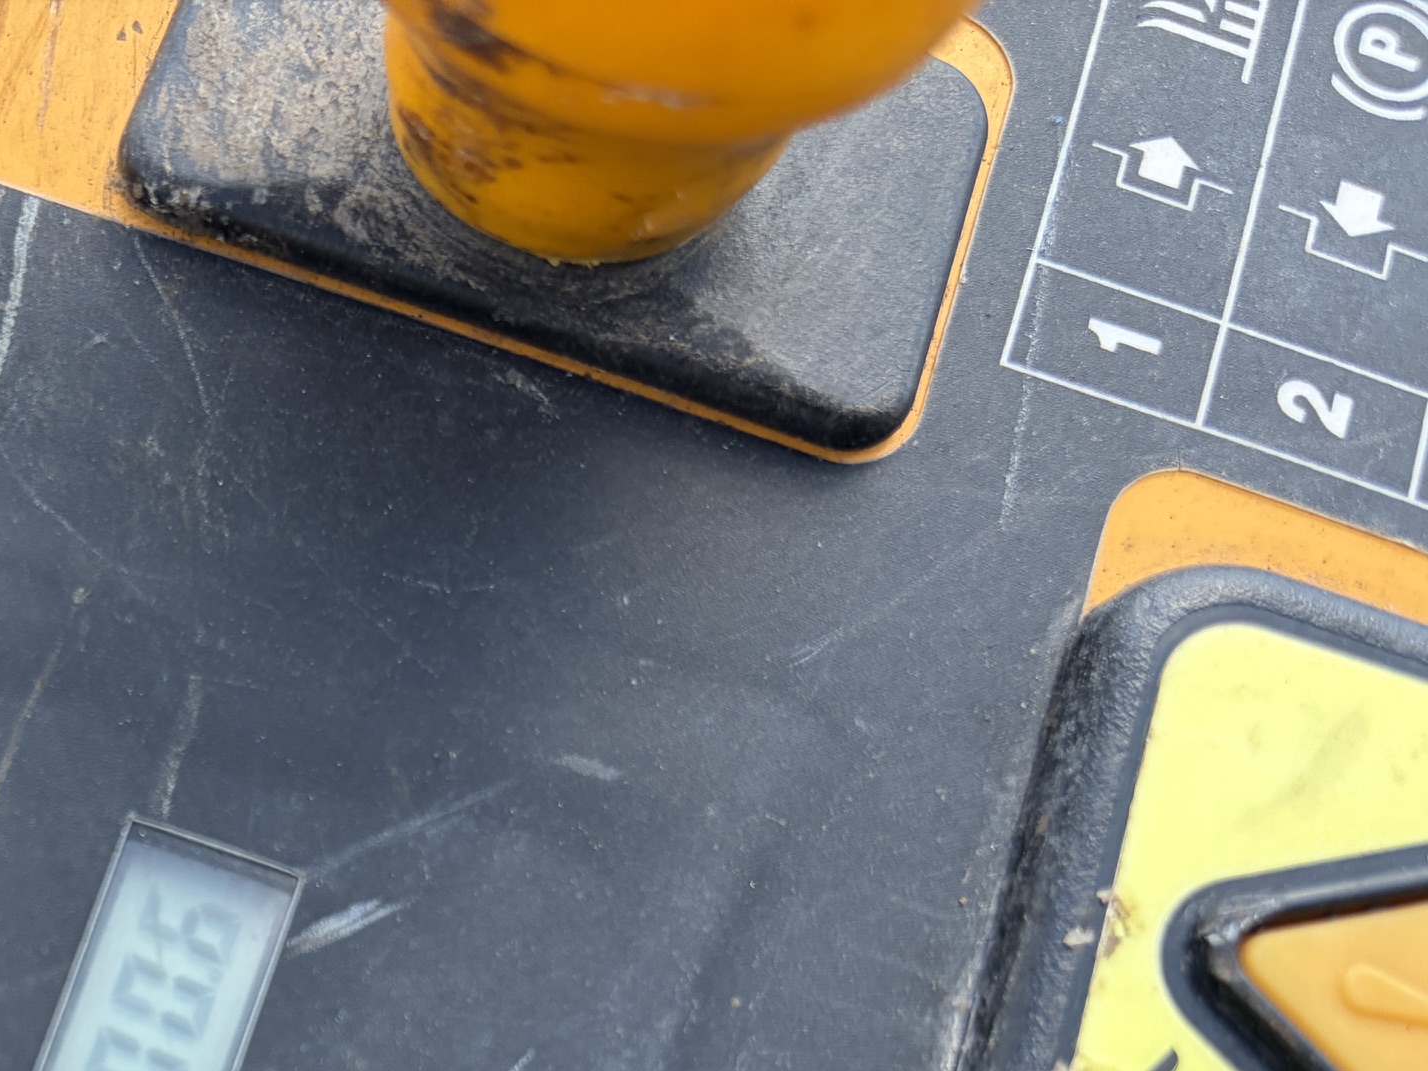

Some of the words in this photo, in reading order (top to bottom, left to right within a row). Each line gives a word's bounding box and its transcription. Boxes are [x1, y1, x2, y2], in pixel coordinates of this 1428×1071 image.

[1358, 26, 1421, 73] P
[1088, 317, 1162, 356] 1
[1277, 379, 1355, 440] 2
